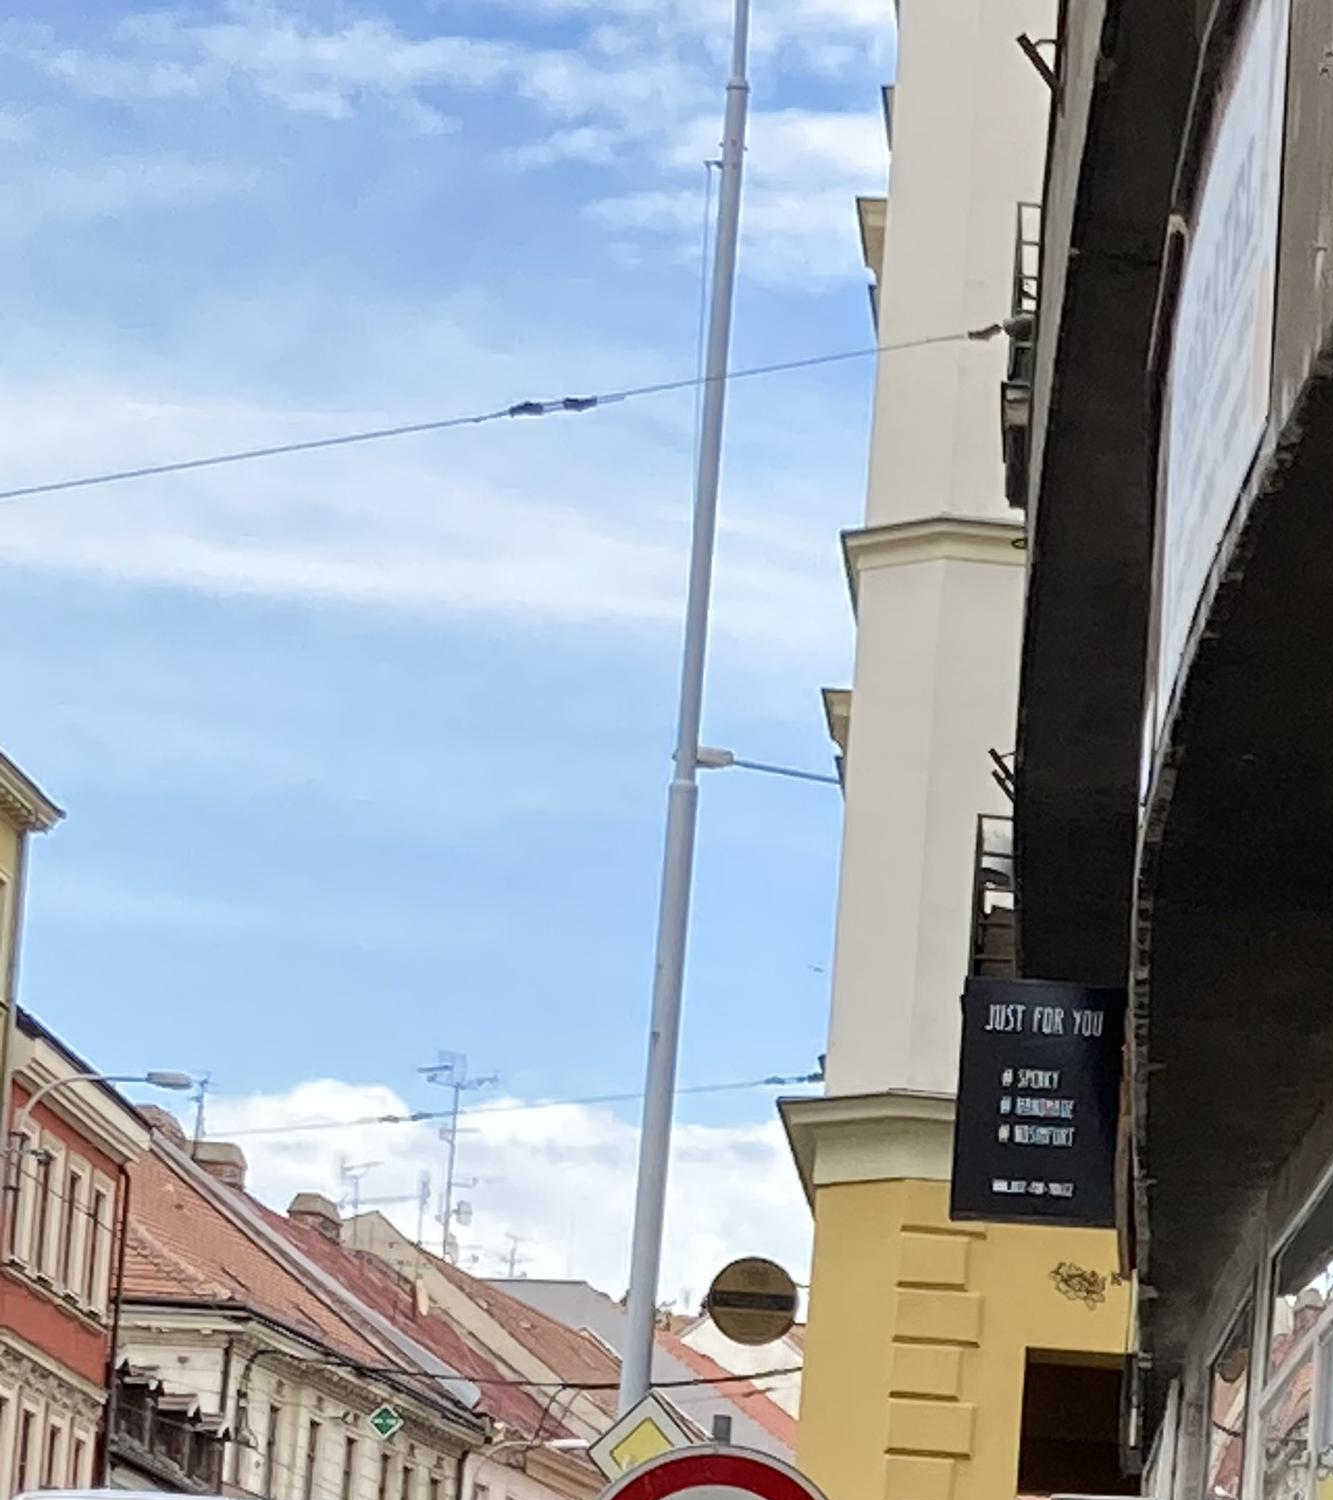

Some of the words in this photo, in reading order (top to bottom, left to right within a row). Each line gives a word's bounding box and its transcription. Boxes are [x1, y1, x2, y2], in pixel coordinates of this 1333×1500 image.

[985, 1004, 1026, 1032] JUST
[1032, 1006, 1064, 1035] FOR
[1072, 1010, 1104, 1037] YOU
